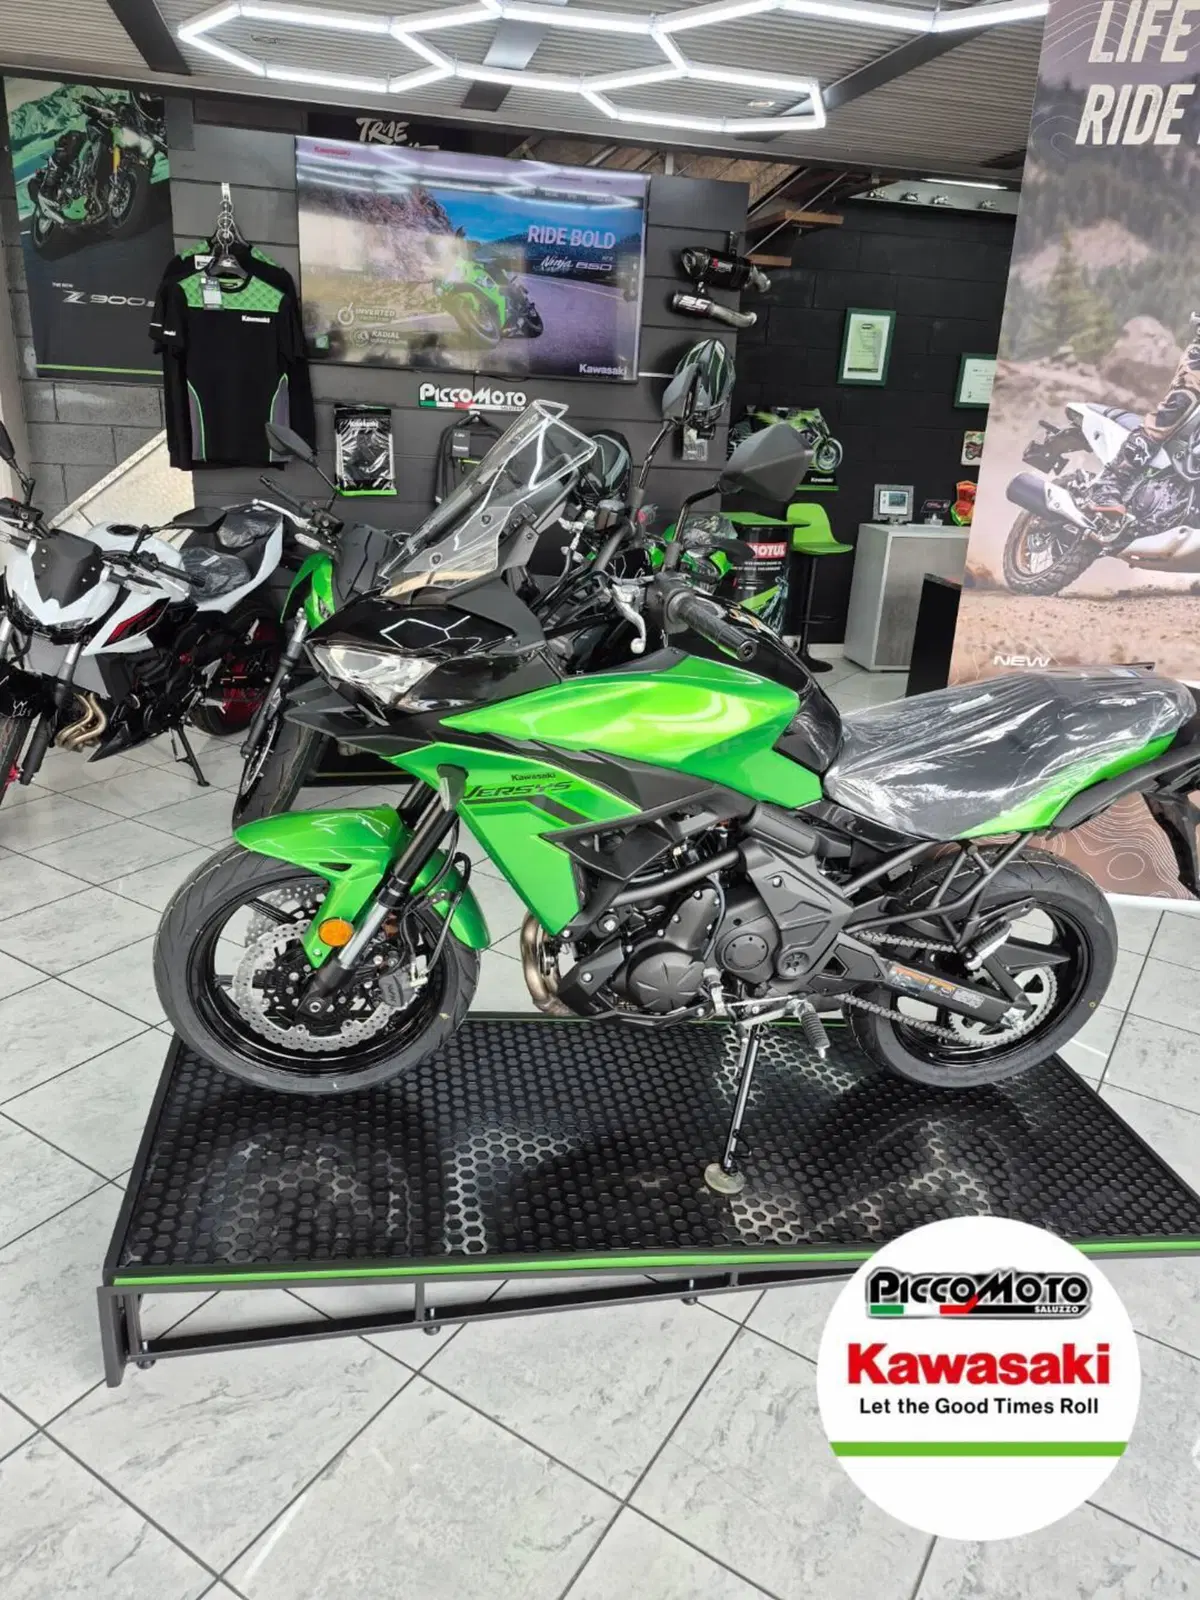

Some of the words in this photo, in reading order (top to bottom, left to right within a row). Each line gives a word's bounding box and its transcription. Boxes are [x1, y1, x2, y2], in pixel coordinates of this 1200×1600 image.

[1088, 0, 1200, 62] LIFE
[1075, 84, 1196, 145] RIDE
[527, 225, 568, 245] RIDE
[570, 230, 616, 249] BOLD
[579, 364, 627, 376] Kawasaki
[993, 656, 1050, 667] NEW
[511, 773, 556, 781] Kawasaki
